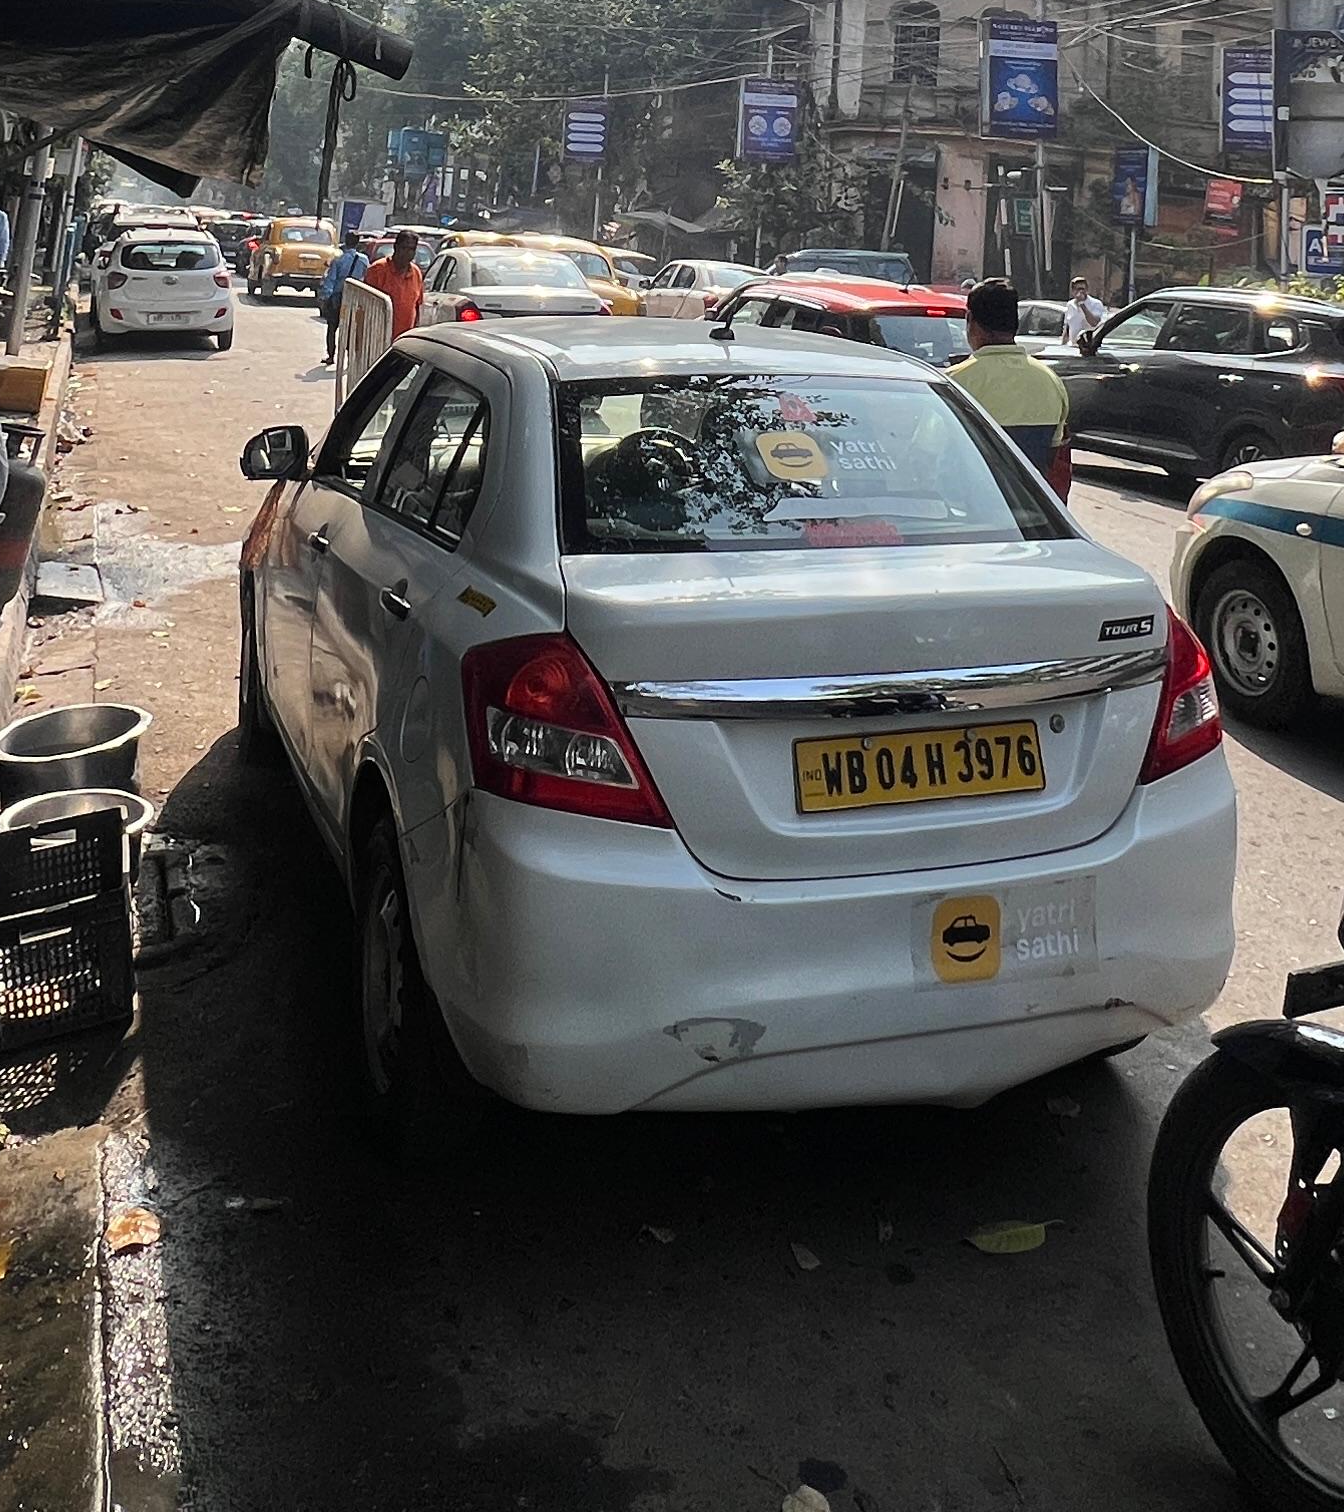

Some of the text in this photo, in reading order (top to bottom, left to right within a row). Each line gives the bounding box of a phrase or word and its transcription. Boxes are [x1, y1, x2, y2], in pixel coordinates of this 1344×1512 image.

[839, 454, 897, 472] sathi
[1104, 623, 1139, 636] TOUR
[822, 735, 1037, 797] WB 04 H 3976
[1017, 897, 1076, 934] yatri
[1016, 928, 1080, 961] sathi
